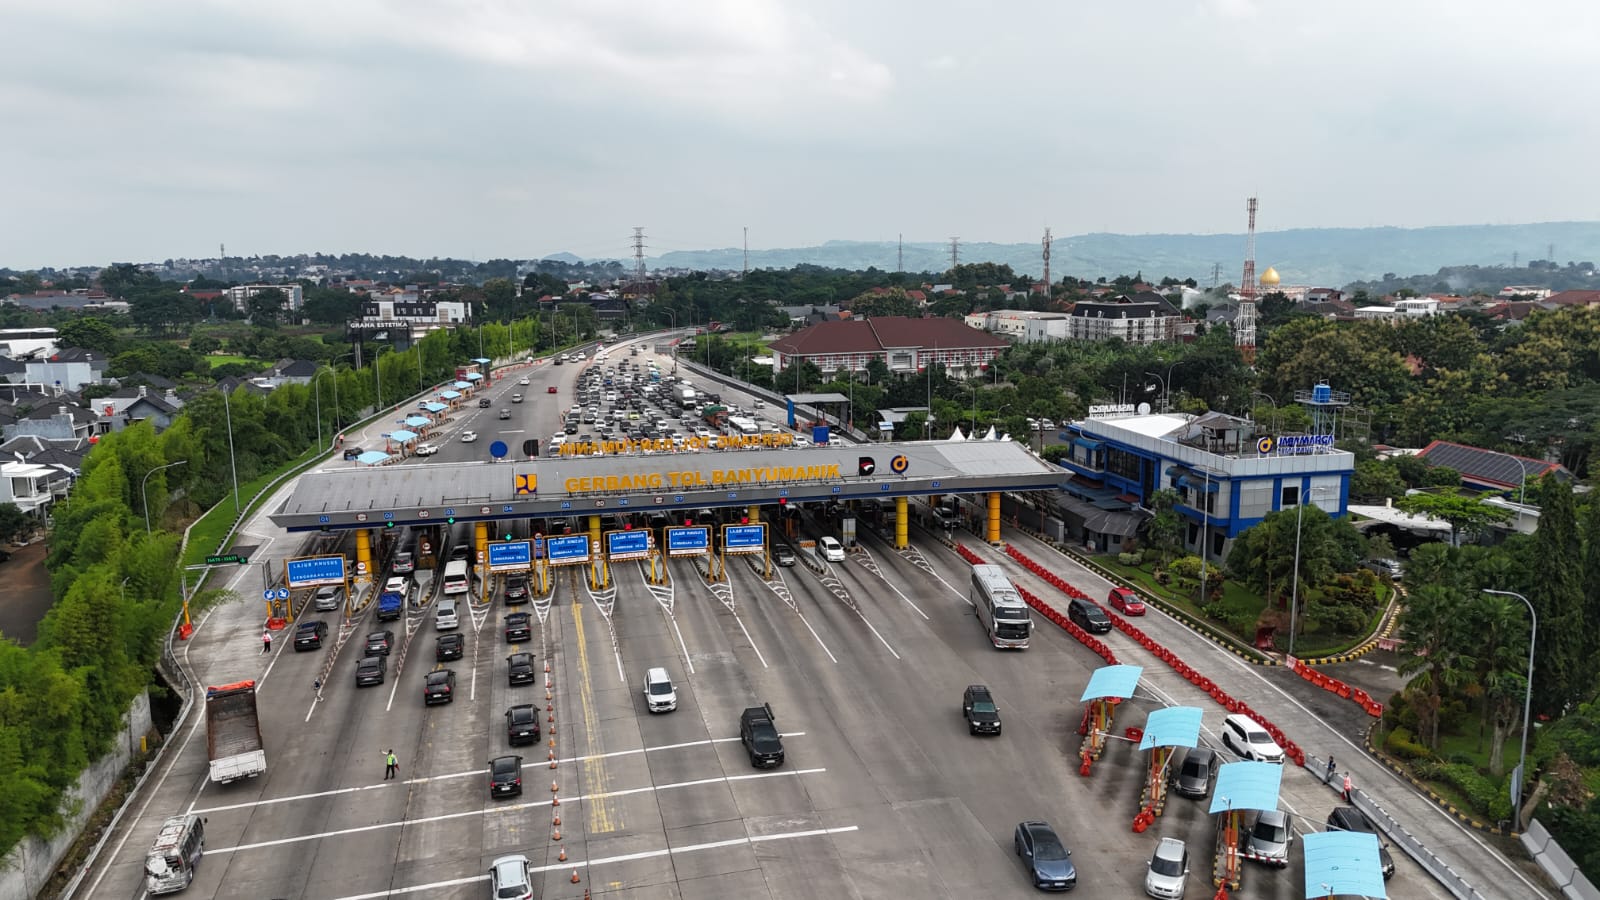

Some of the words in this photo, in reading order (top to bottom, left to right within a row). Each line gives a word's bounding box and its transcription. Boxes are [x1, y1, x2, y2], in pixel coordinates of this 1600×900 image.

[565, 472, 662, 493] GERBANG
[668, 471, 707, 487] TOL
[712, 464, 841, 485] BANYUMANIK
